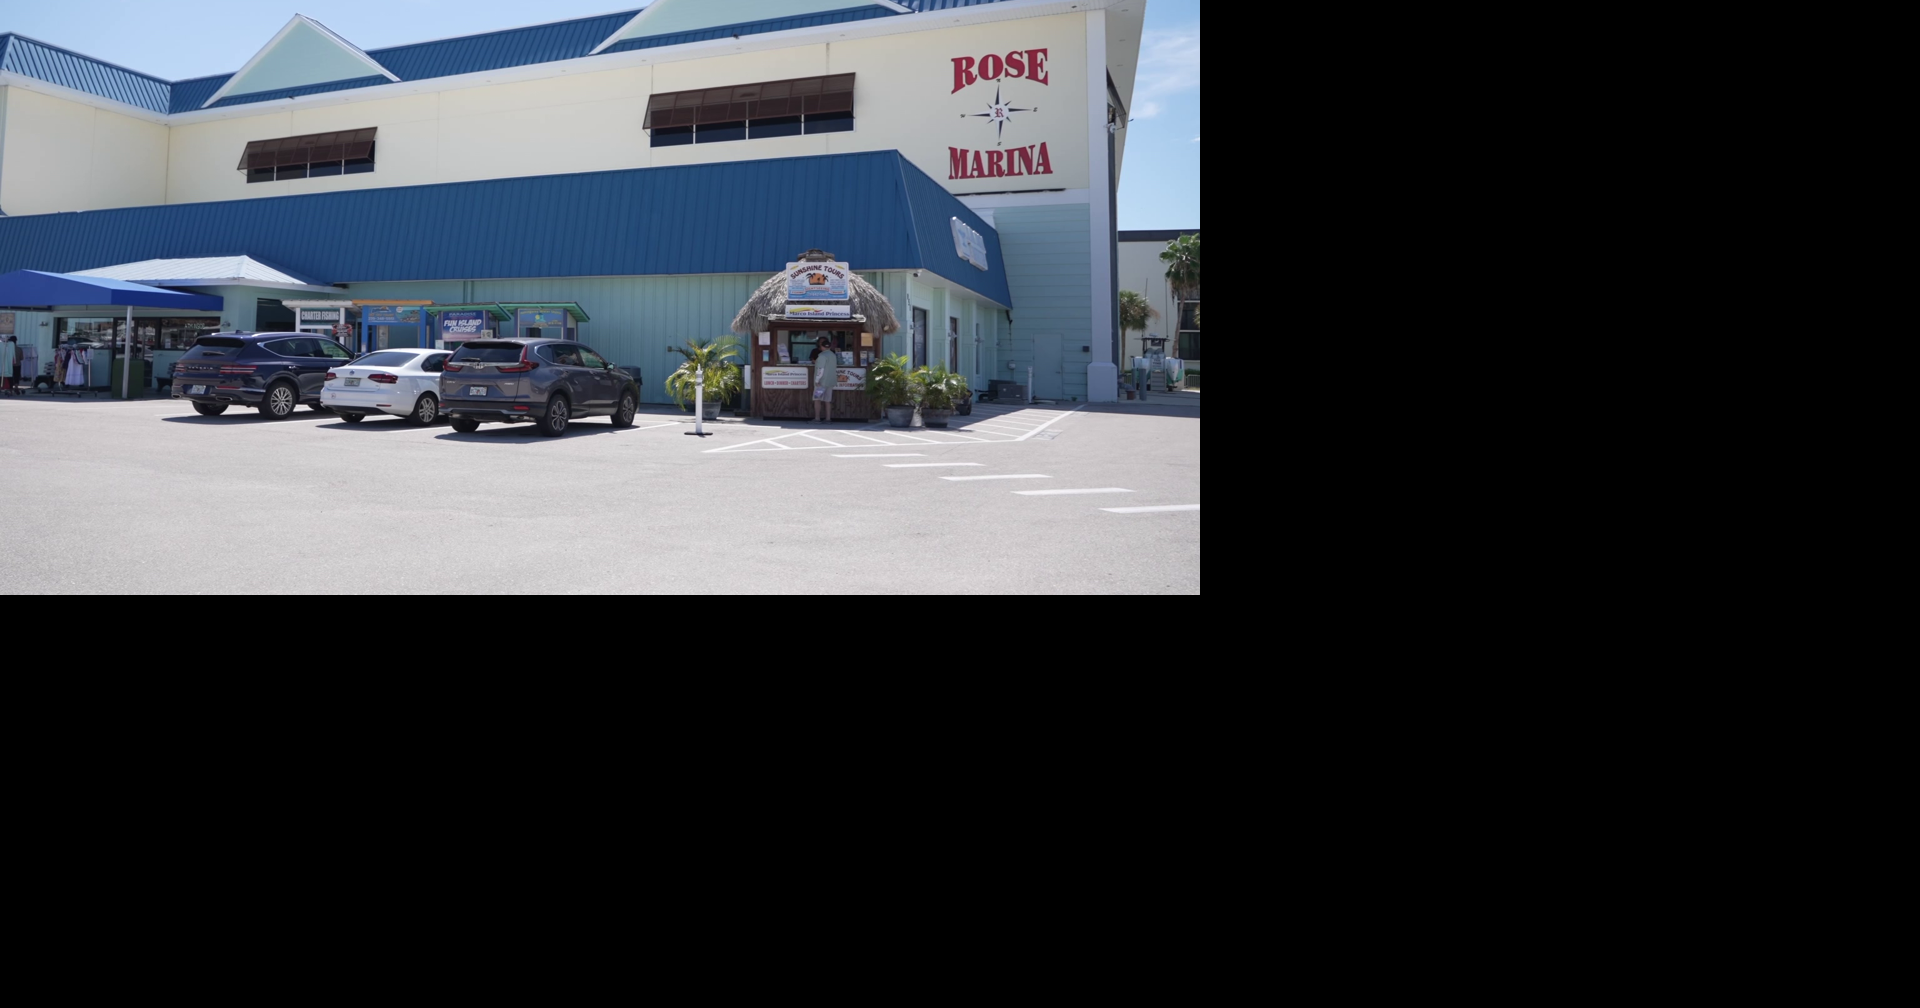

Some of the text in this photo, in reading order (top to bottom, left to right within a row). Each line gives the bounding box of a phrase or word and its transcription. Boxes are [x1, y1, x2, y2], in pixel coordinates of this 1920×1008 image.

[951, 48, 1048, 95] ROSE
[948, 141, 1053, 180] MARINA
[790, 265, 845, 280] SUNSHINE TOURS
[301, 310, 340, 320] CHARTER FISHING
[443, 318, 482, 327] FUN ISLAND
[449, 325, 477, 333] CRUISES
